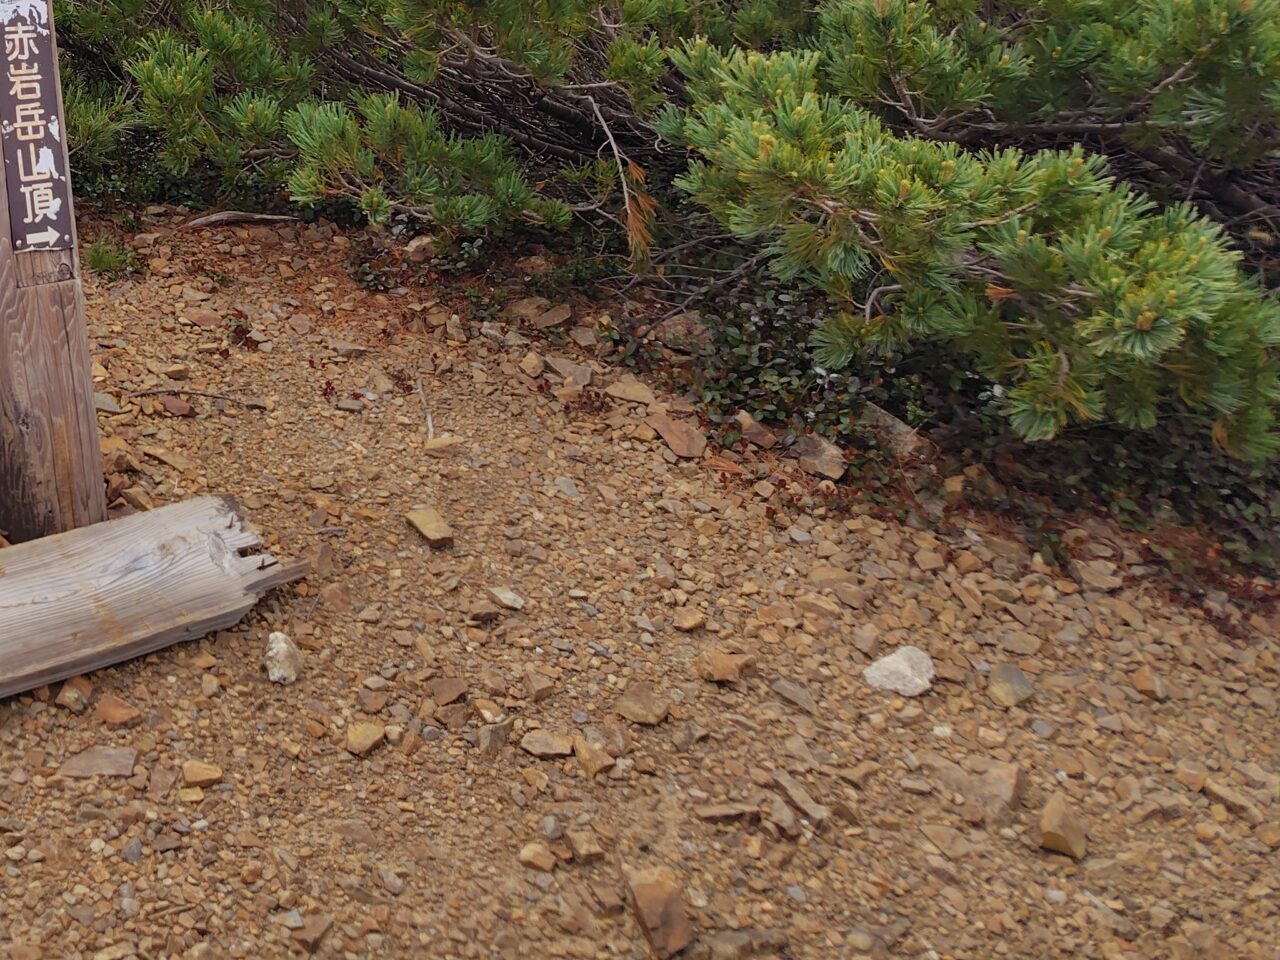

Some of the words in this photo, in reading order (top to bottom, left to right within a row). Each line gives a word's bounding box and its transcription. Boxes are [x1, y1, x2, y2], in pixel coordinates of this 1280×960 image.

[4, 22, 57, 224] 赤岩岳山頂
